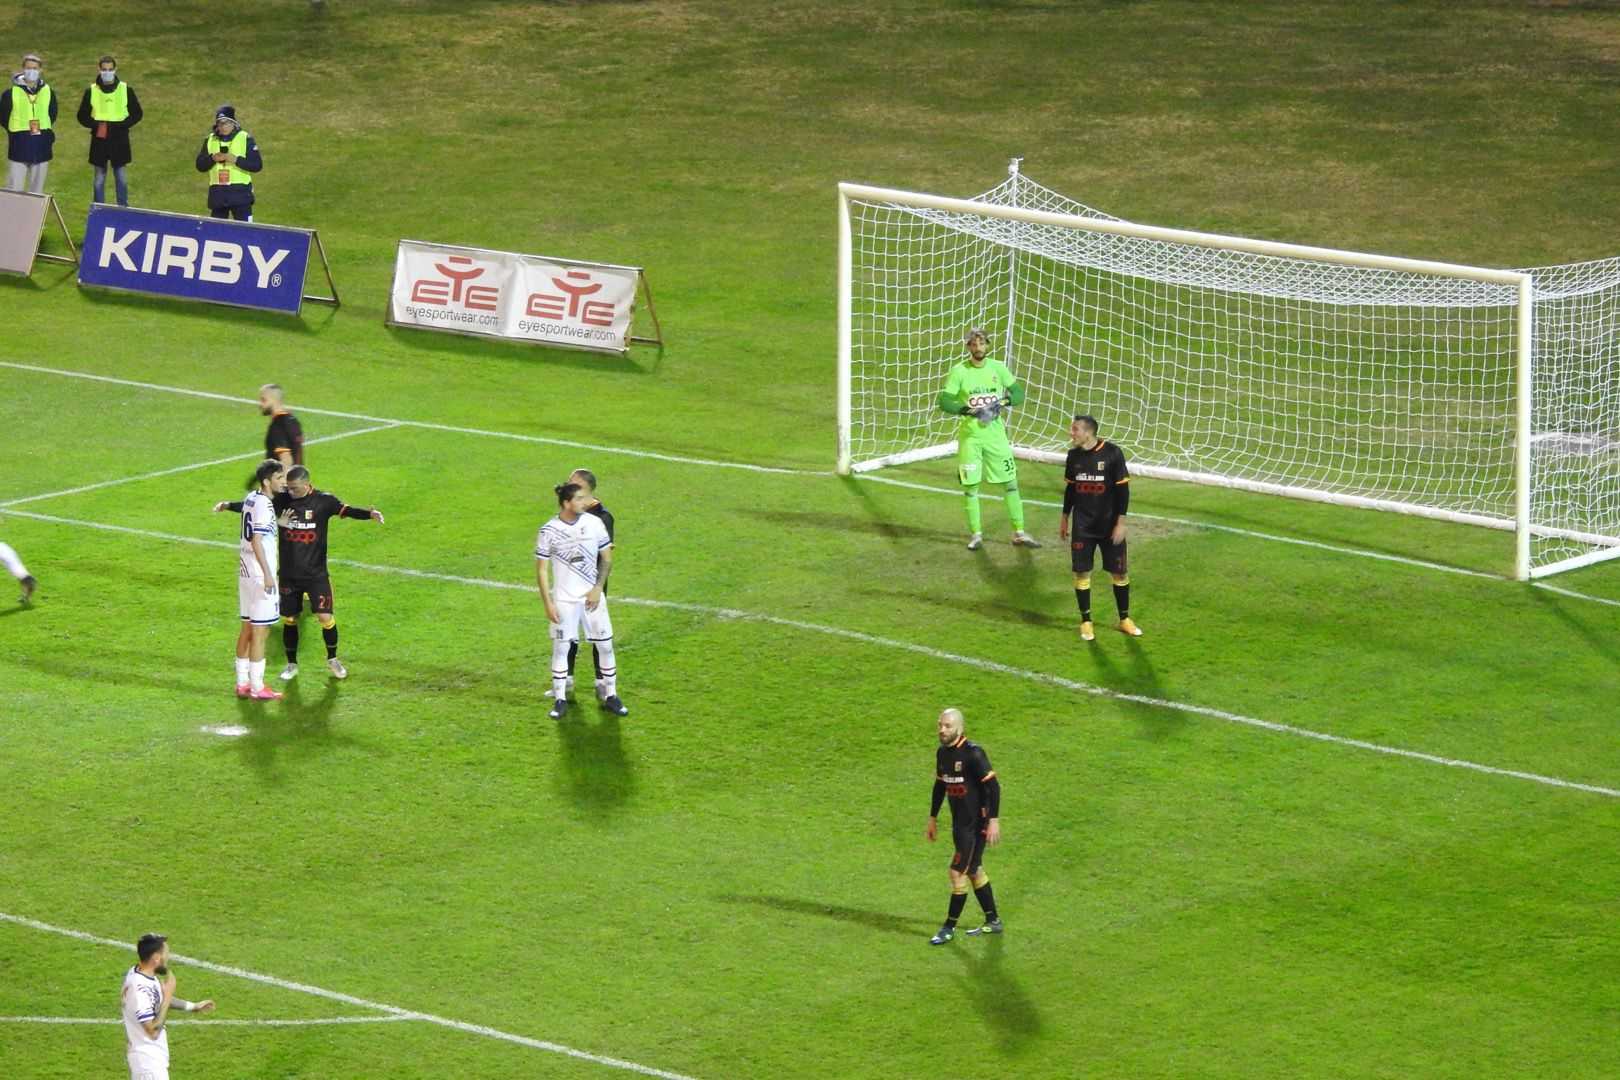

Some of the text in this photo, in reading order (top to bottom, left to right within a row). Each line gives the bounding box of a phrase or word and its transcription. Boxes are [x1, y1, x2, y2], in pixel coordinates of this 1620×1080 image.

[99, 227, 290, 289] KIRBY
[411, 256, 499, 311] EYE
[405, 304, 499, 328] eyesportwear.com
[525, 271, 615, 327] EYE
[518, 319, 617, 342] eyesportwear.com
